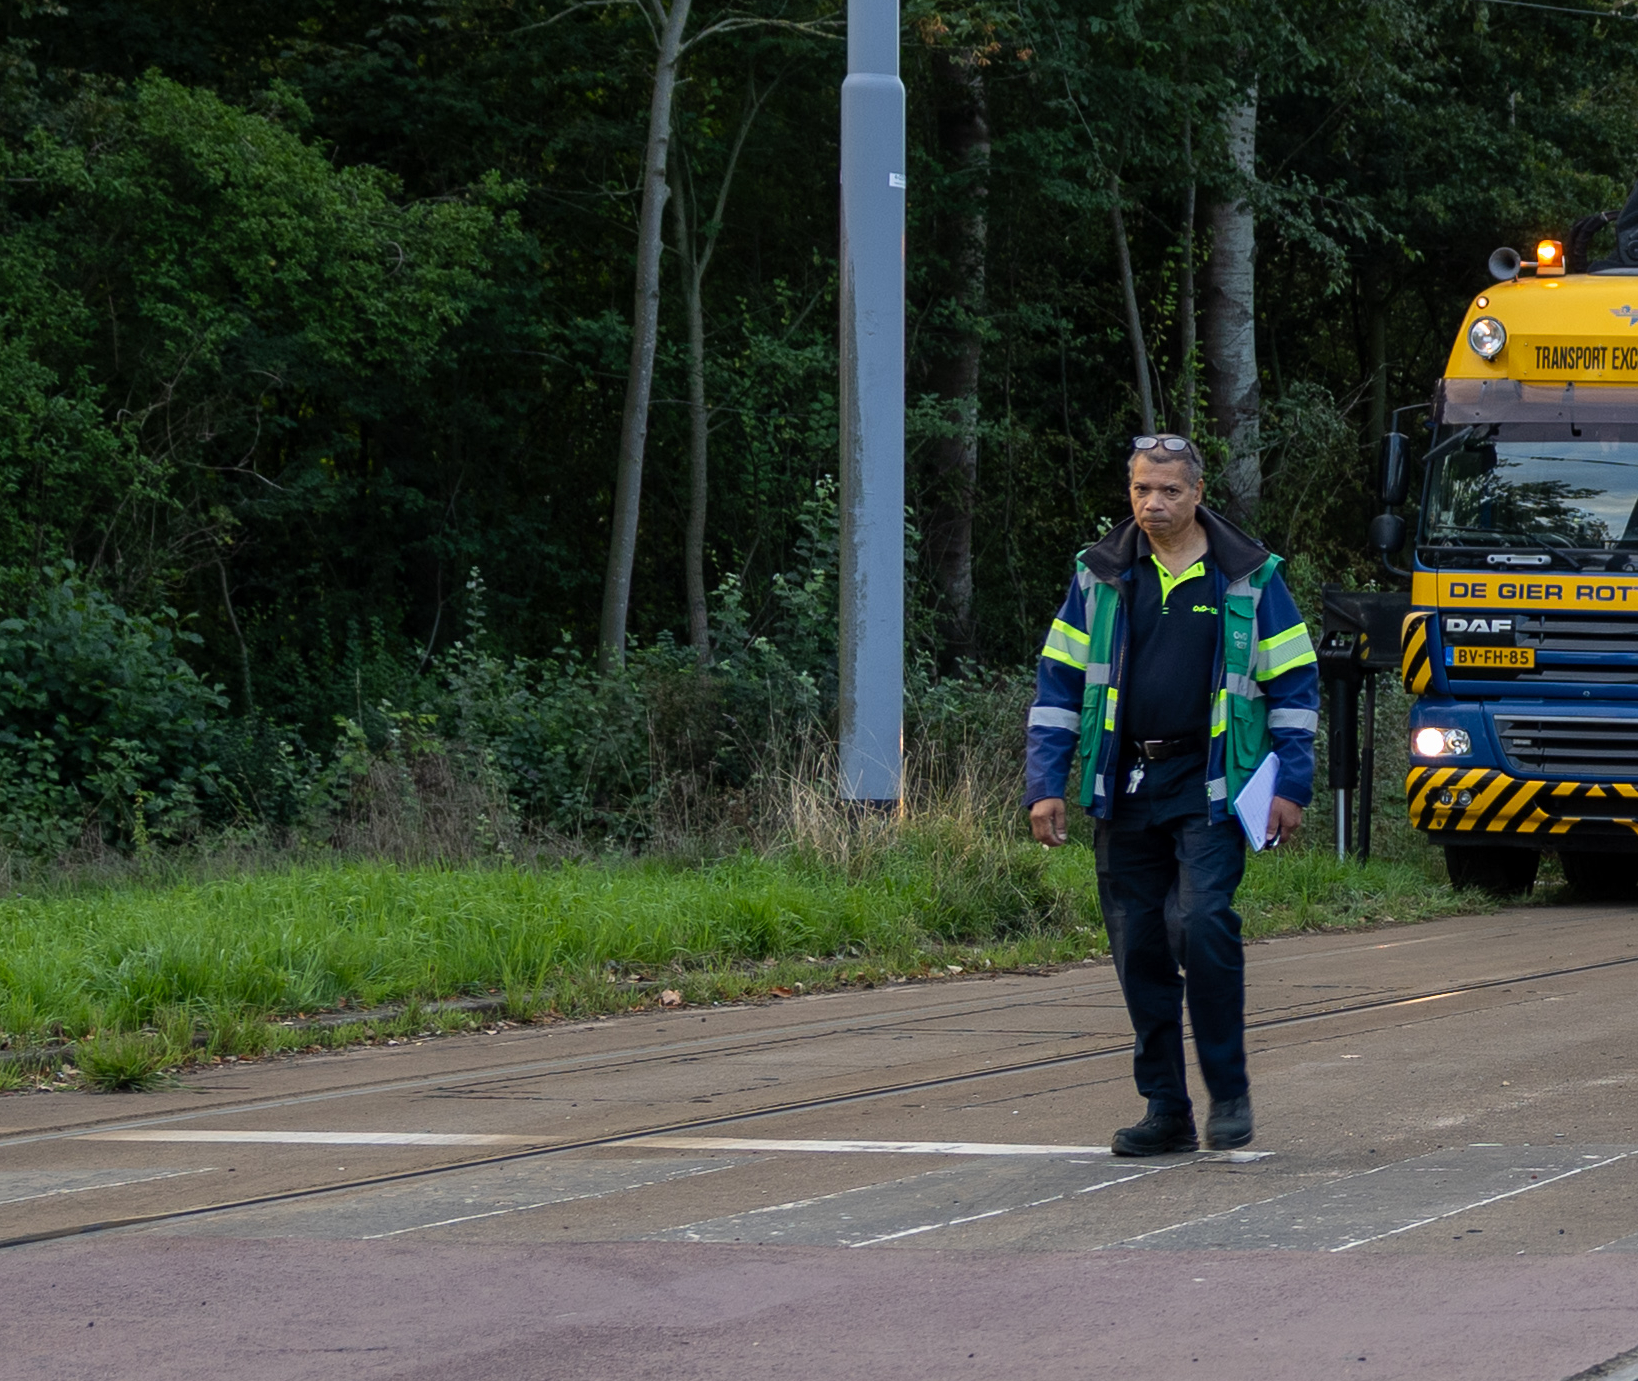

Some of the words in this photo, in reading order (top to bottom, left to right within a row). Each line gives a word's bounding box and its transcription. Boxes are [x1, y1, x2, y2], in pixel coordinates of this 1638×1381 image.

[1535, 346, 1608, 370] TRANSPORT
[1450, 582, 1487, 599] DE
[1498, 584, 1563, 600] GIER
[1446, 619, 1512, 632] DAF
[1458, 649, 1529, 664] BV-FH-85
